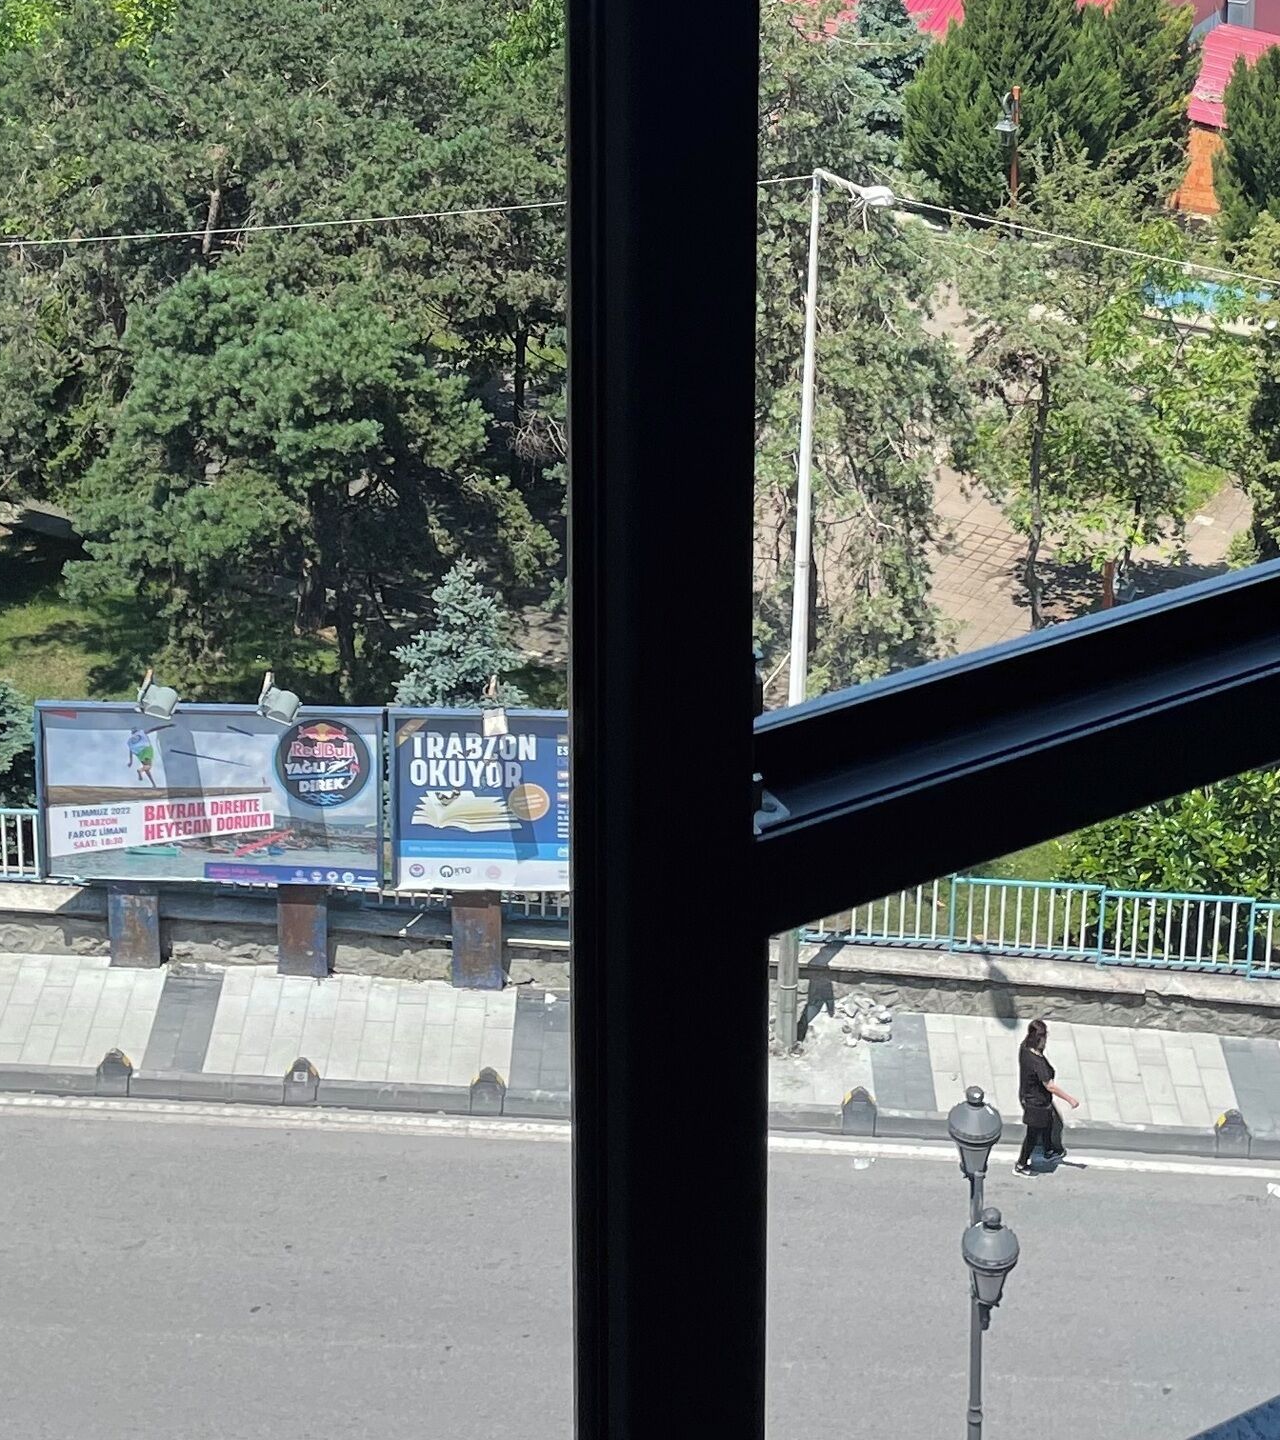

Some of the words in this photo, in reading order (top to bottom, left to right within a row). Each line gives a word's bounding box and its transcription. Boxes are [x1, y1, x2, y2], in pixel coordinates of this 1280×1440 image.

[291, 741, 325, 758] Red
[325, 742, 355, 759] Bull
[411, 732, 537, 761] TRABZON
[410, 759, 522, 788] OKUYOR
[72, 808, 109, 818] TEMMUZ
[111, 807, 131, 815] 2022
[144, 802, 207, 821] BAYRAK
[79, 817, 118, 827] TRABZON
[144, 818, 212, 841] HEYECAN
[217, 813, 271, 831] DORUKTA
[68, 829, 97, 839] FAROZ
